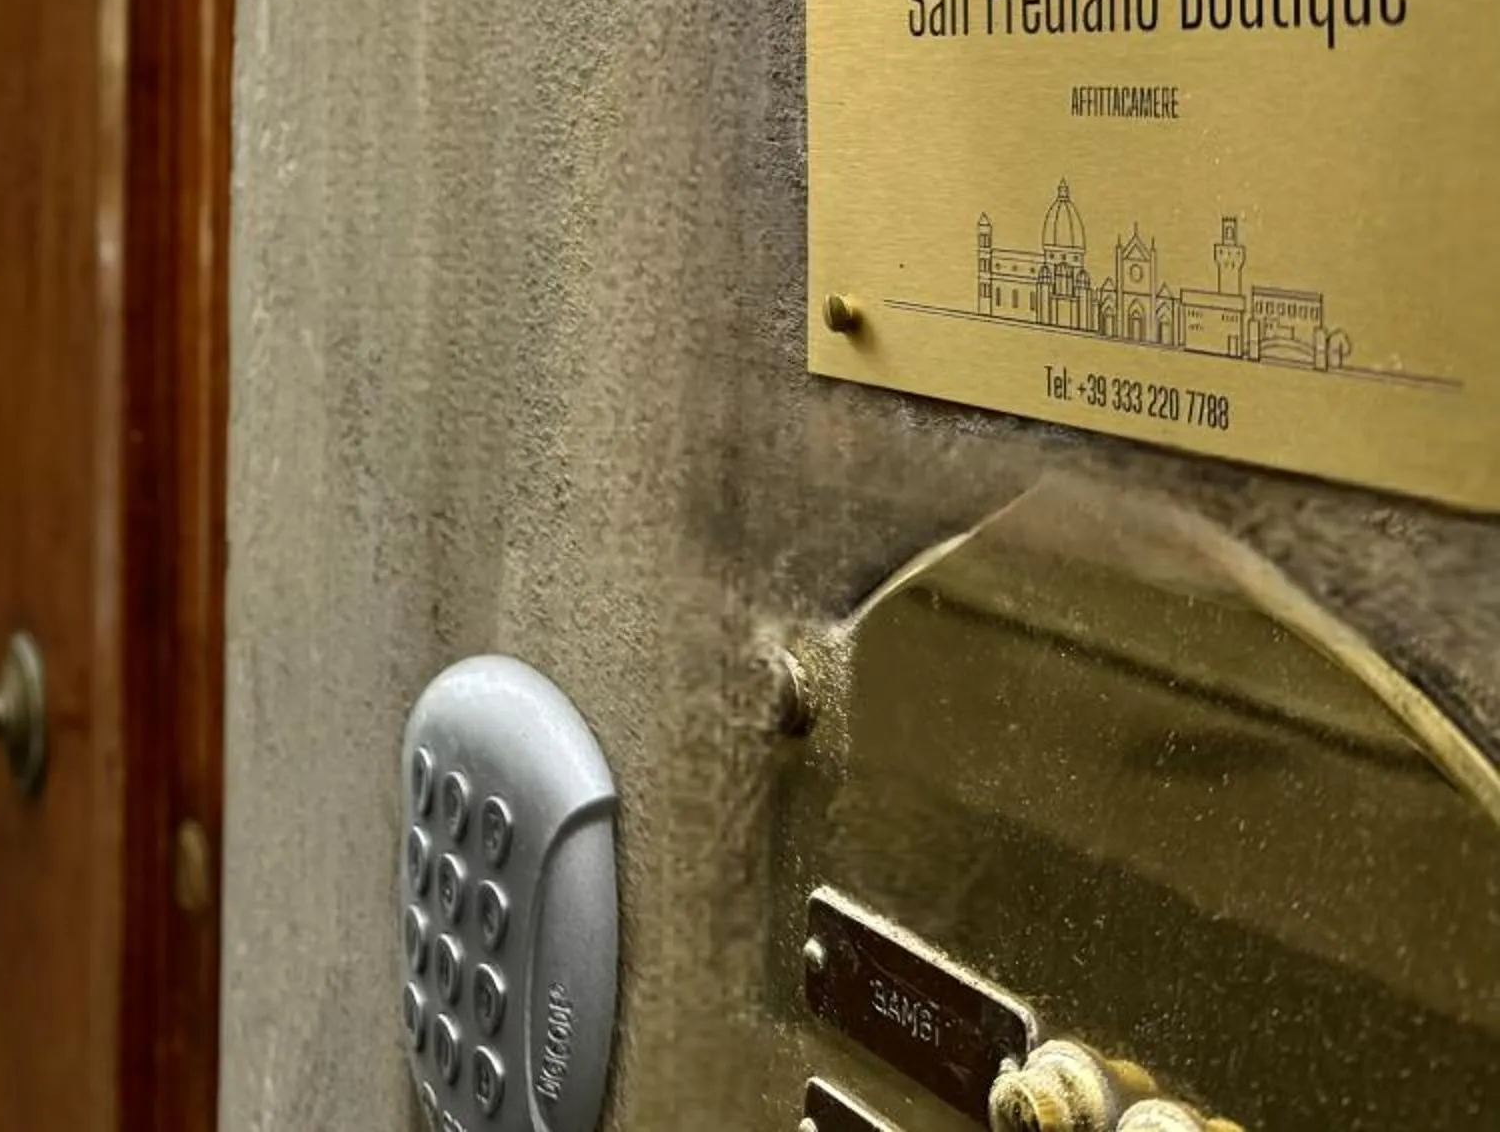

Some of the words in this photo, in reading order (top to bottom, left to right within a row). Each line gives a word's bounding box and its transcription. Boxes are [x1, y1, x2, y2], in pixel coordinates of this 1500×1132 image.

[1070, 85, 1180, 119] AFFITTACAMERE
[1043, 365, 1073, 401] Tel:
[1077, 373, 1107, 407] +39
[1111, 377, 1143, 414] 333
[1147, 384, 1180, 421] 220
[1185, 389, 1230, 431] 7788
